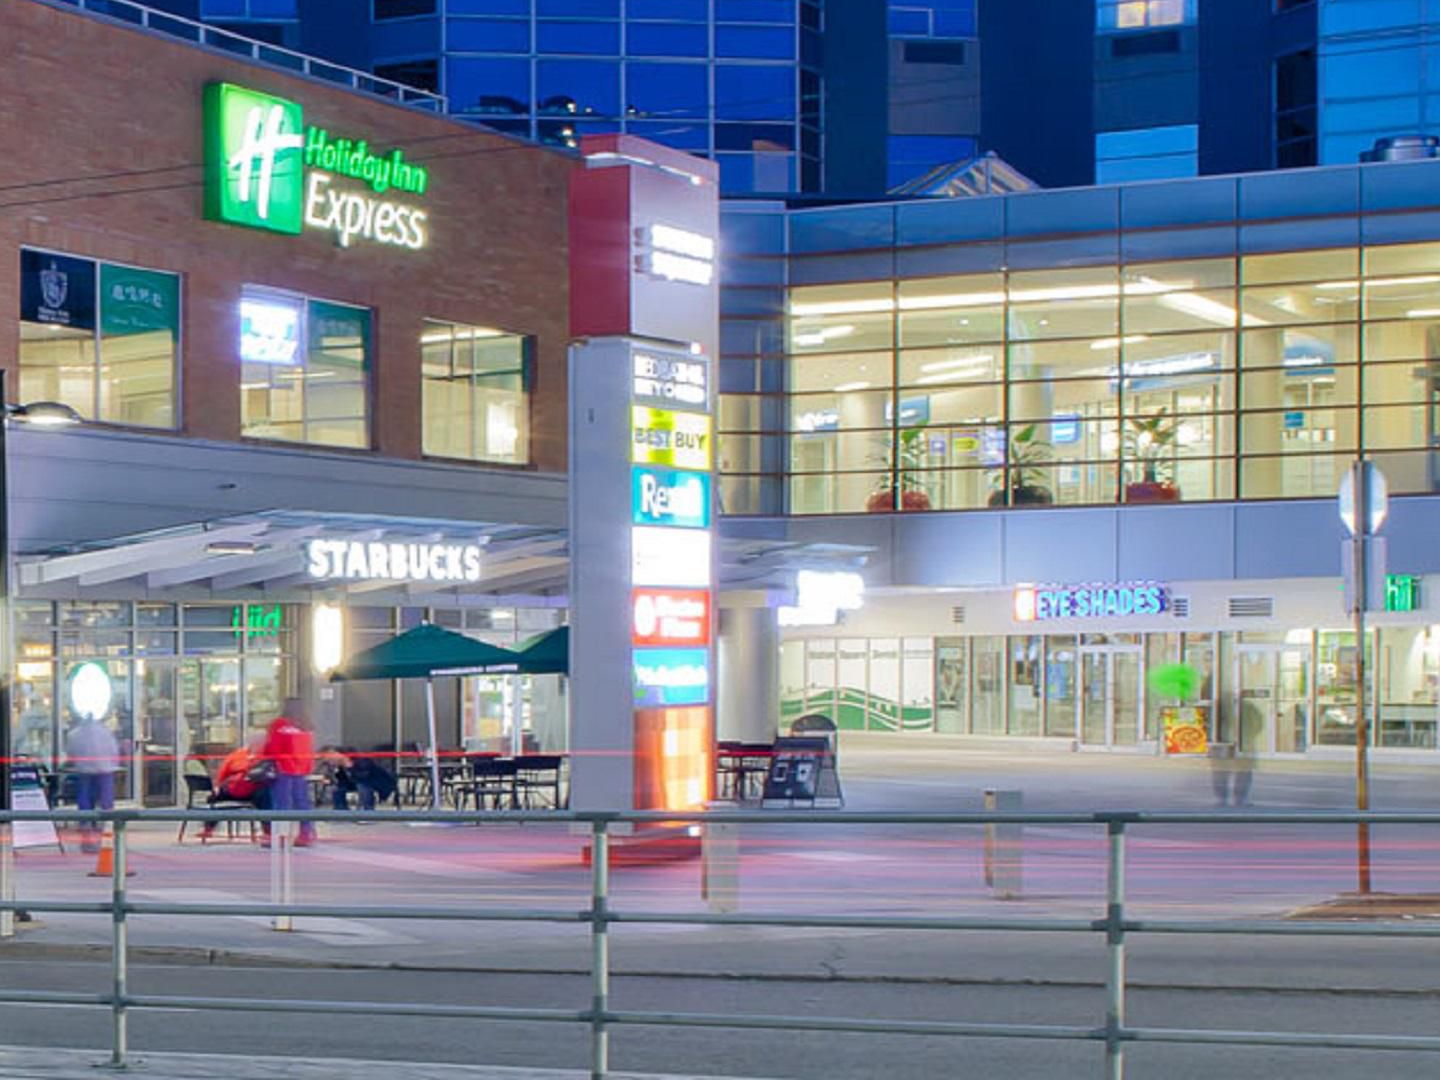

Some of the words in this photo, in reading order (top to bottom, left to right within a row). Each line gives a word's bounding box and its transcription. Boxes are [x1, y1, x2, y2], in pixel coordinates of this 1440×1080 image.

[306, 125, 389, 193] Holiday
[391, 149, 428, 195] Inn
[305, 172, 429, 248] Express
[675, 431, 707, 450] BUY
[308, 538, 481, 582] STARBUCKS
[1036, 591, 1071, 619] EYE
[1073, 587, 1162, 617] SHADES
